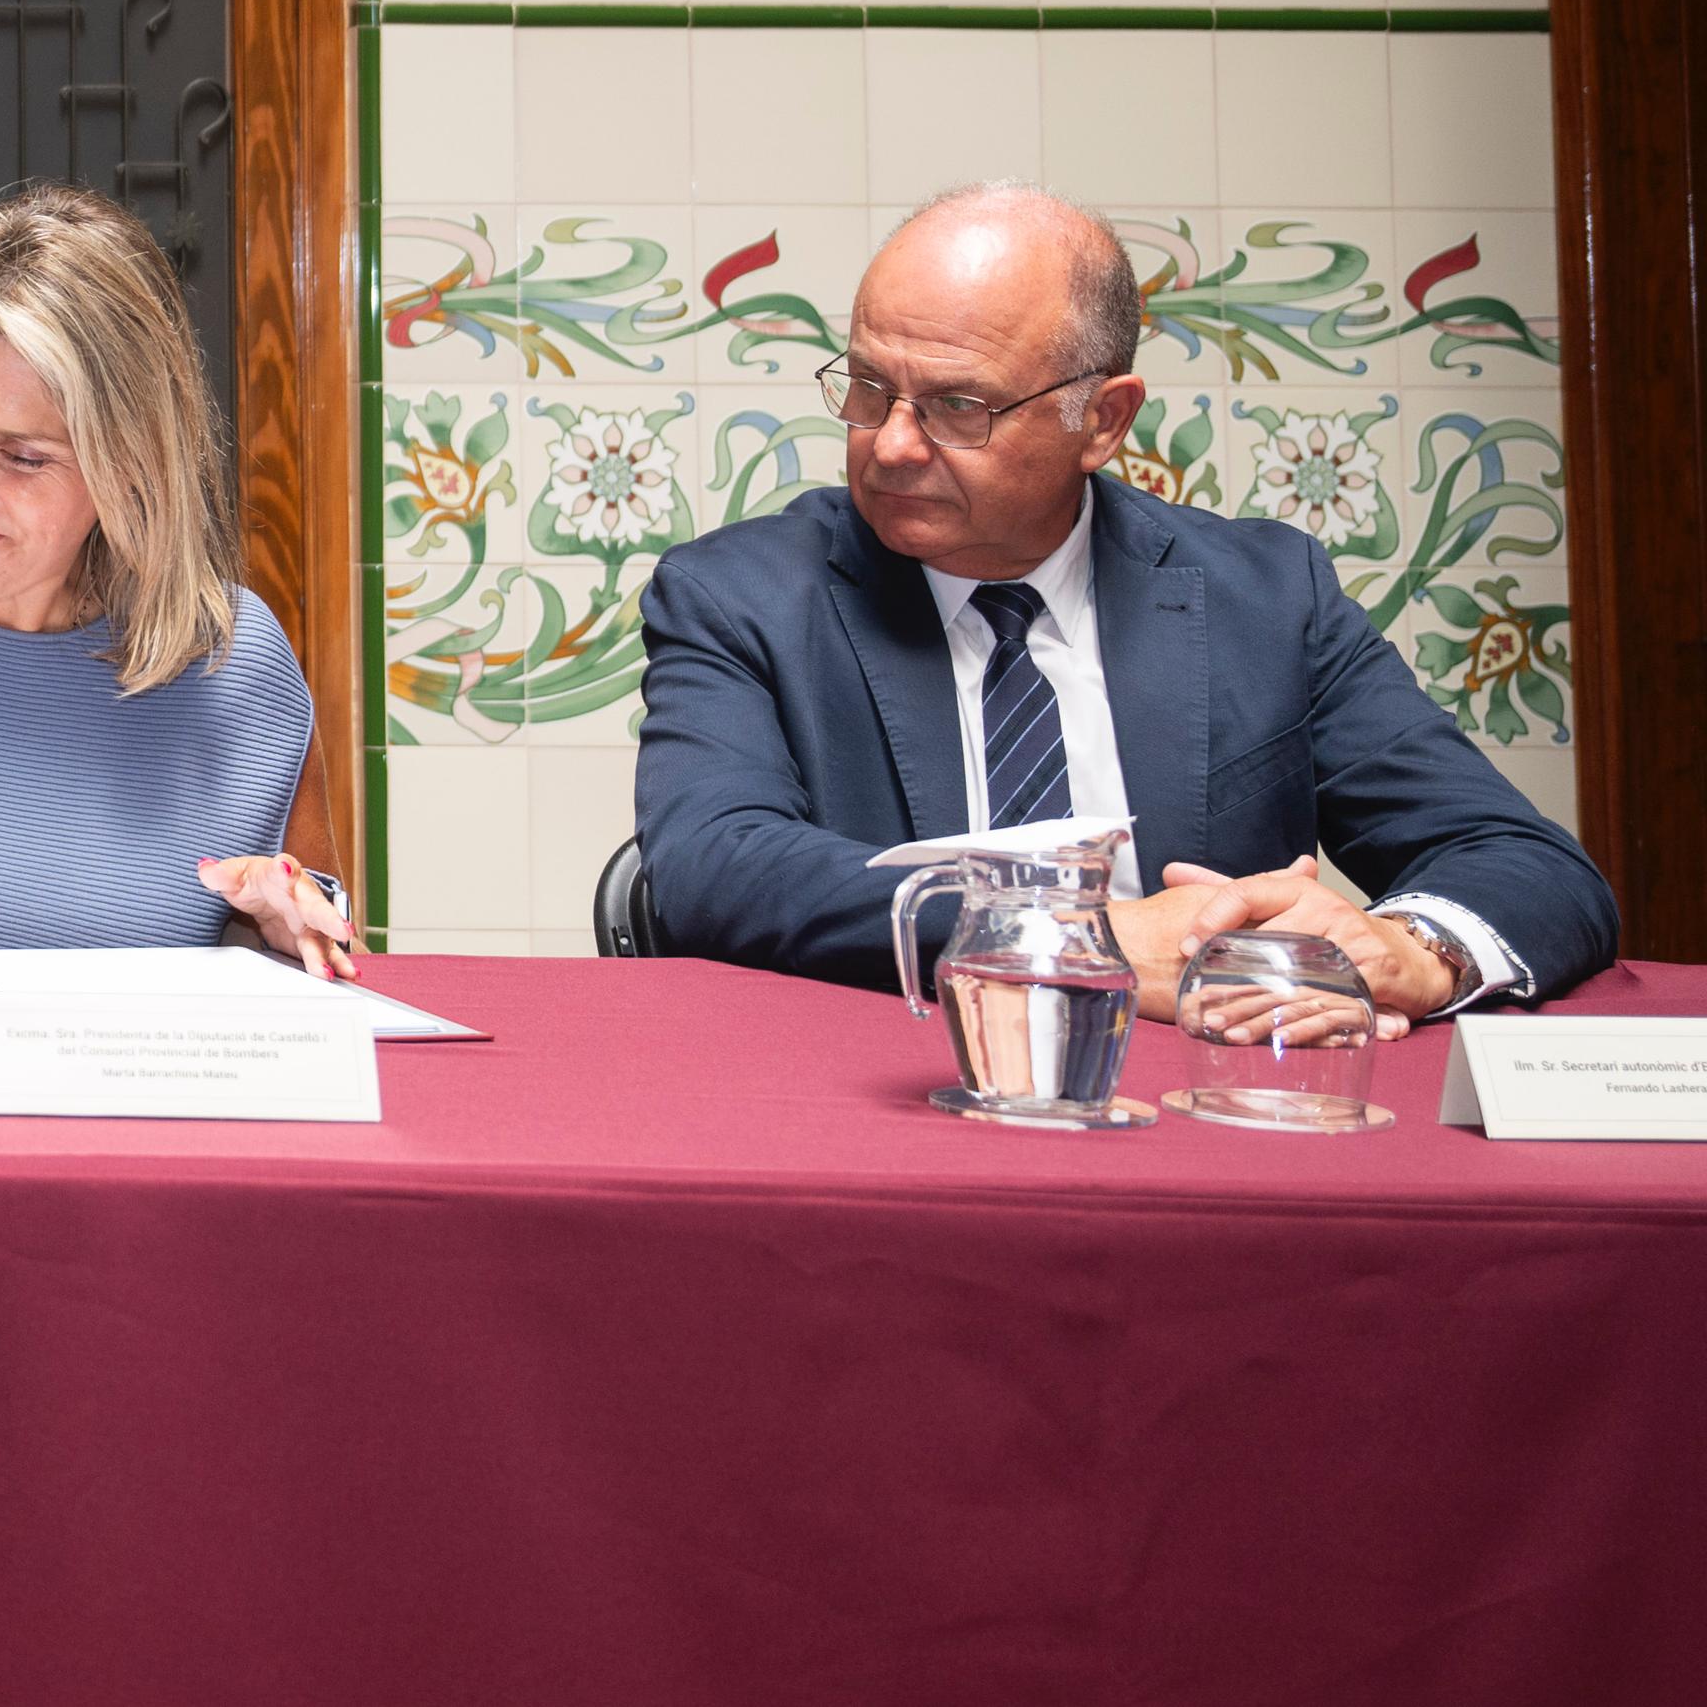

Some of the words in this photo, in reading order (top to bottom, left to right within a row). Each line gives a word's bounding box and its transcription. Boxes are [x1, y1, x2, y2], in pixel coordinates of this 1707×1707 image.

[1561, 1060, 1619, 1072] Secretari
[1691, 1061, 1707, 1072] d'E
[1606, 1082, 1660, 1094] Fernando
[1663, 1083, 1707, 1094] Lashera
